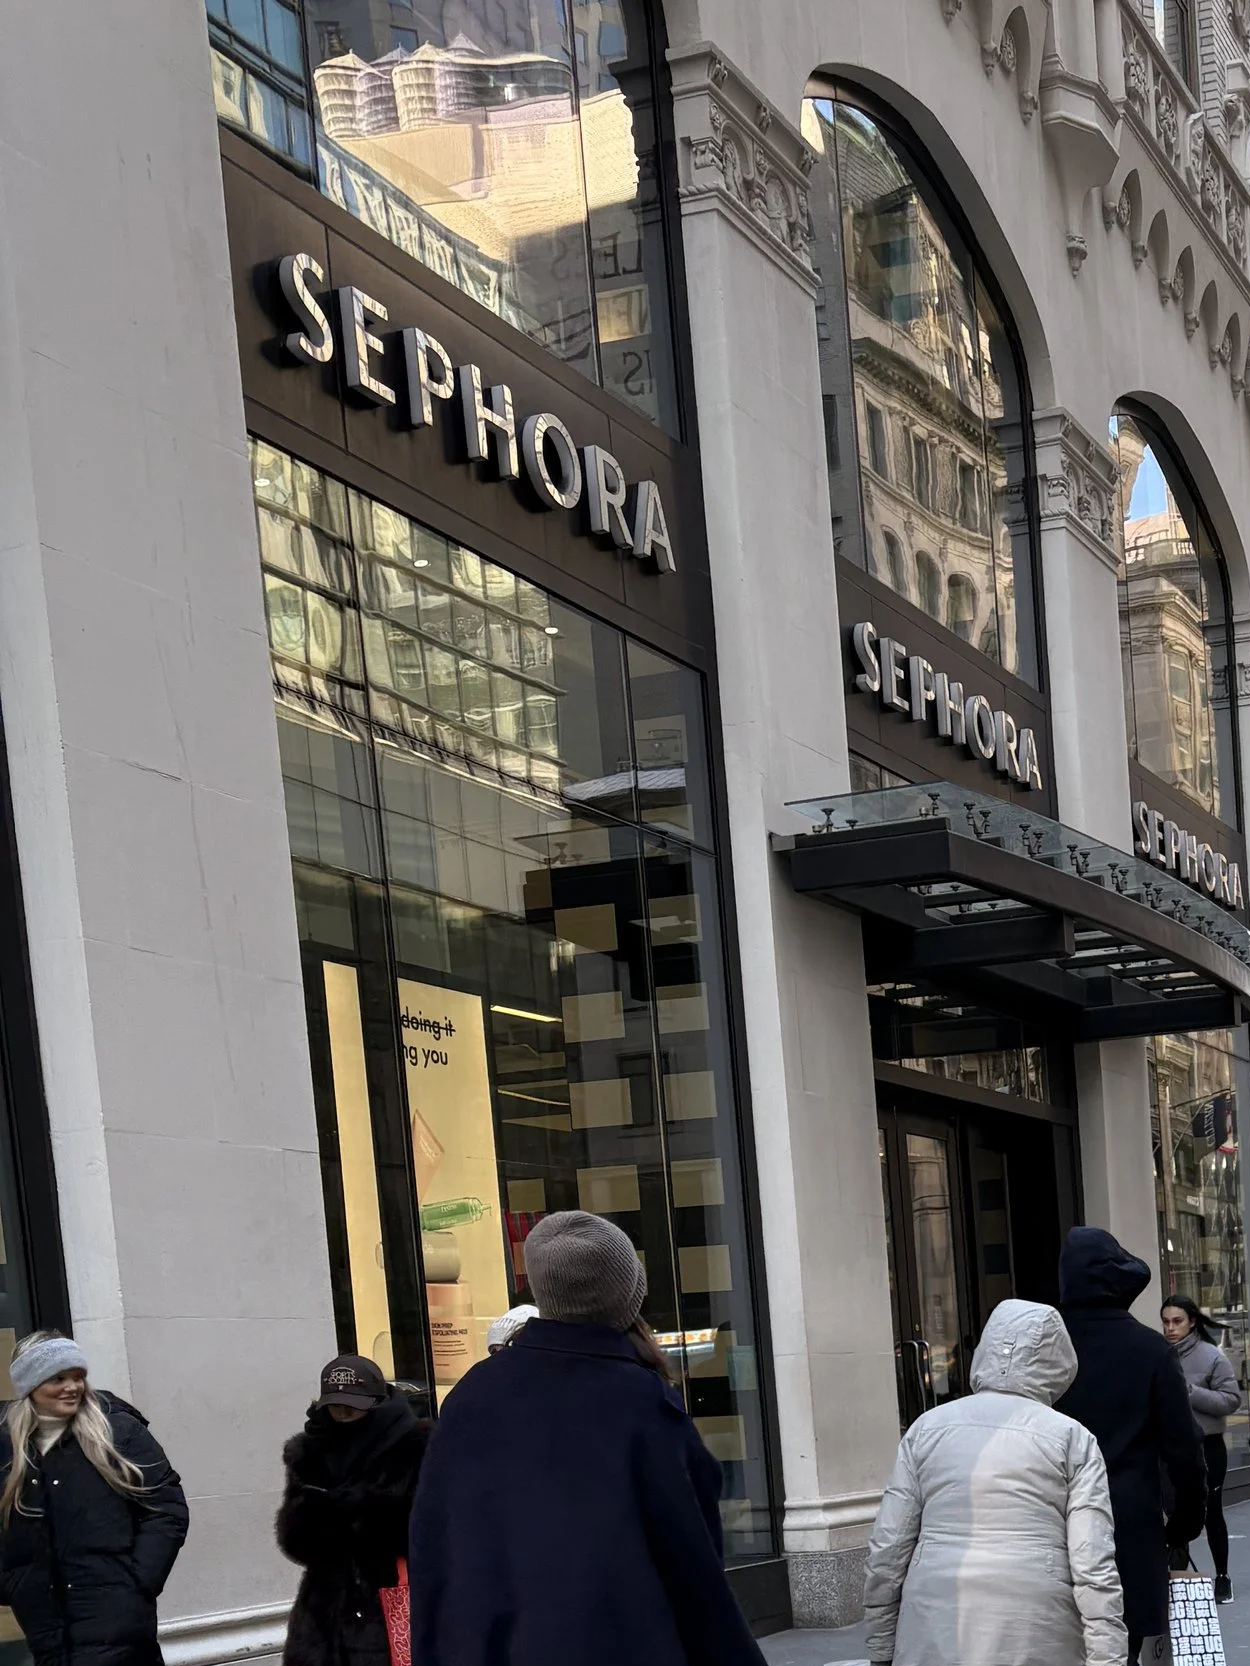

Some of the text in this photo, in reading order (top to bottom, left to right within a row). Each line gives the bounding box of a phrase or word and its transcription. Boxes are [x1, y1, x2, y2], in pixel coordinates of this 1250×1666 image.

[279, 253, 676, 574] SEPHORA
[853, 621, 1043, 790] SEPHORA
[1132, 801, 1244, 910] SEPHORA
[401, 1006, 441, 1041] doing
[421, 1048, 449, 1069] you
[1186, 1583, 1214, 1601] UGG
[1180, 1618, 1209, 1637] UGG
[1203, 1635, 1224, 1653] UG
